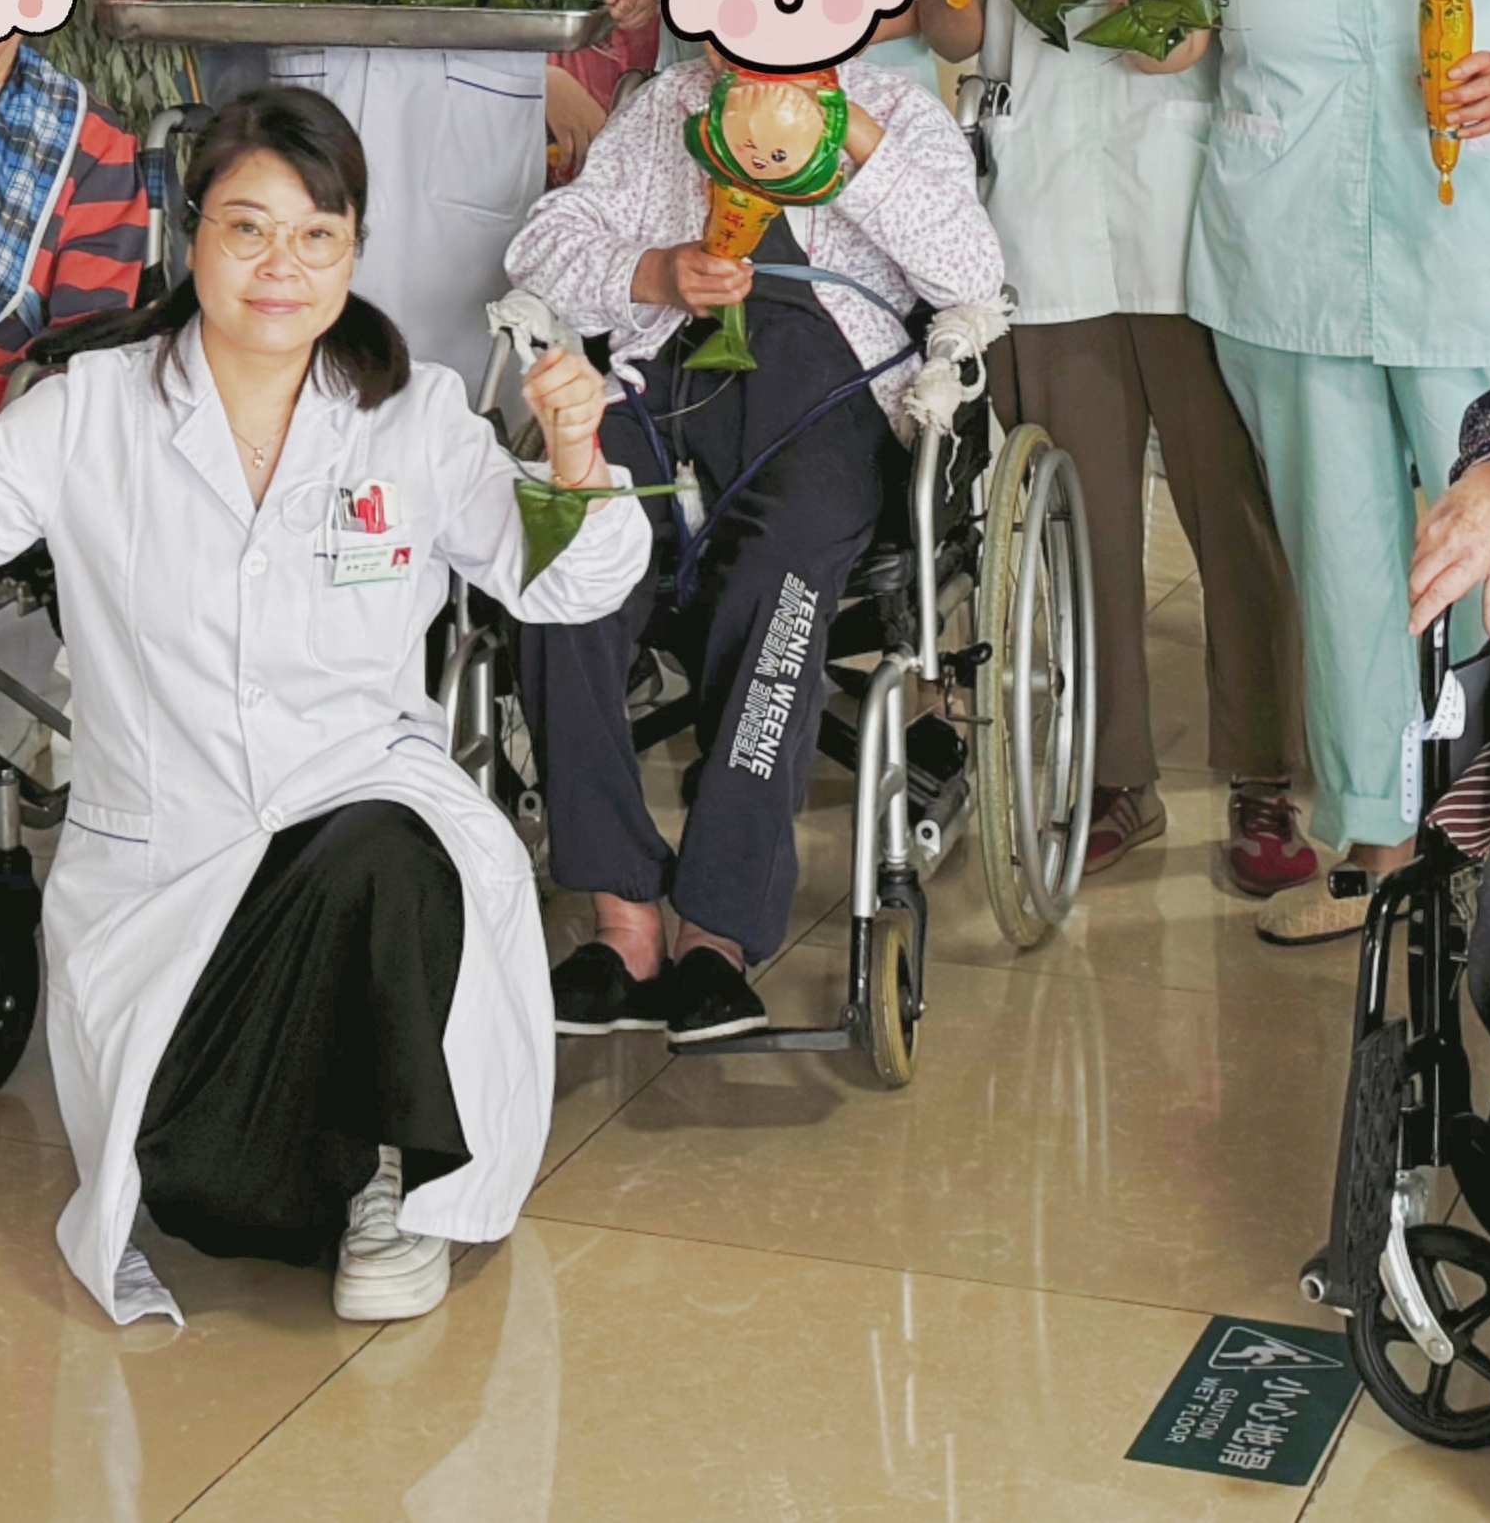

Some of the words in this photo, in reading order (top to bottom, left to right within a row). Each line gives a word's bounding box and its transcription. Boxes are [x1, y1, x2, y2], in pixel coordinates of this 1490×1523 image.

[780, 589, 820, 680] TEENIE
[750, 681, 797, 780] WEENIE
[1164, 1403, 1205, 1444] FLOOR
[1194, 1376, 1222, 1404] WET
[1195, 1388, 1239, 1440] CAUTION
[1218, 1377, 1311, 1470] 小心地滑
